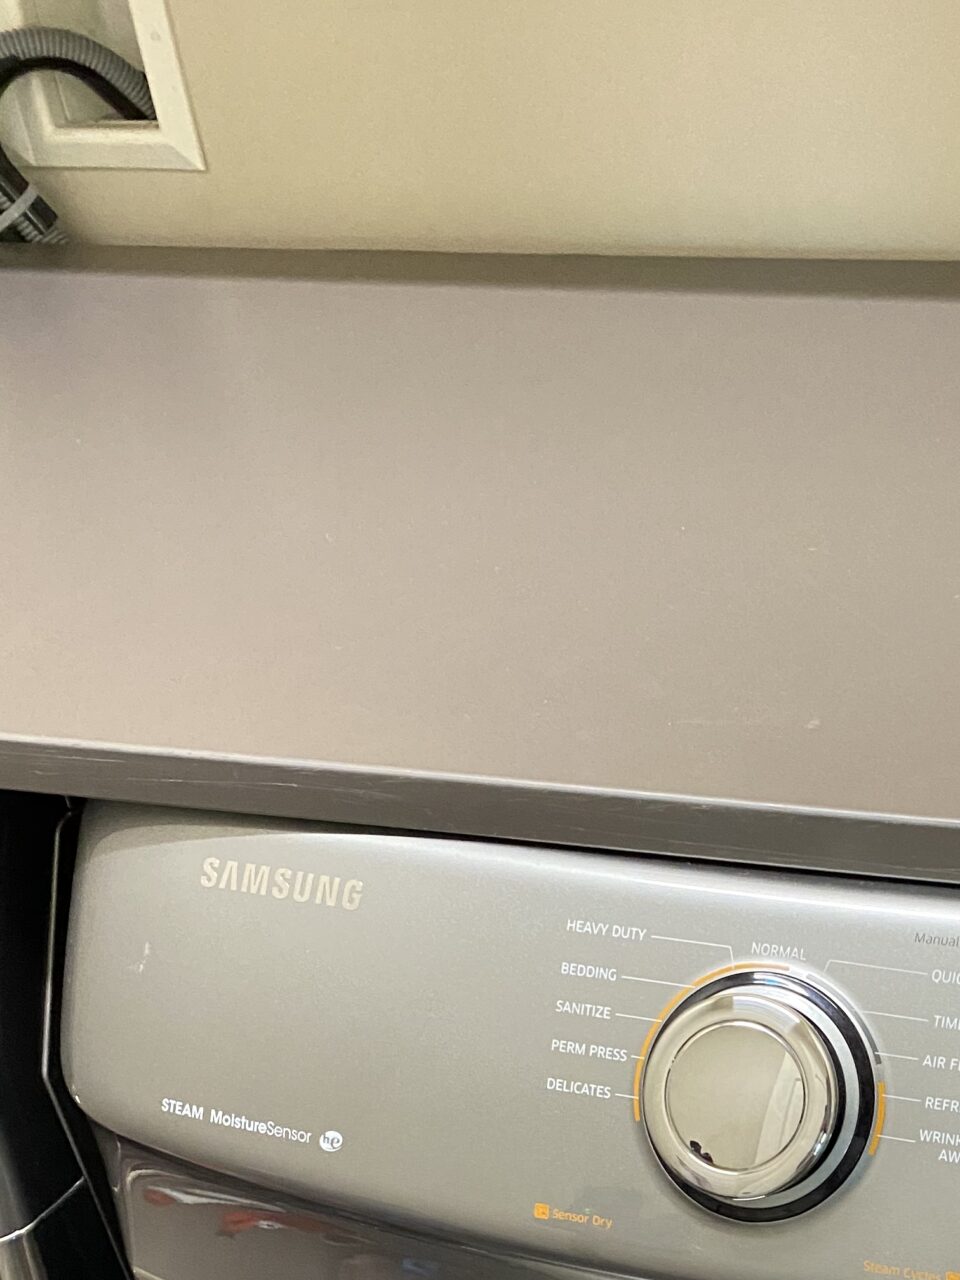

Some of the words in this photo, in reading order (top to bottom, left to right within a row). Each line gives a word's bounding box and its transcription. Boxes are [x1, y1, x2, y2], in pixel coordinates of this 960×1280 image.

[200, 856, 363, 911] SAMSUNG
[566, 919, 609, 936] HEAVY
[612, 924, 647, 941] DUTY
[914, 932, 960, 948] Manual
[751, 941, 806, 961] NORMAL
[560, 961, 617, 982] BEDDING
[555, 1000, 612, 1020] SANITIZE
[551, 1039, 586, 1056] PERM
[588, 1044, 628, 1062] PRESS
[922, 1054, 946, 1069] AIR
[546, 1077, 612, 1099] DELICATES
[161, 1097, 204, 1120] STEAM
[210, 1108, 312, 1144] MoistureSensor
[552, 1208, 590, 1225] Sensor
[592, 1214, 613, 1230] Dry
